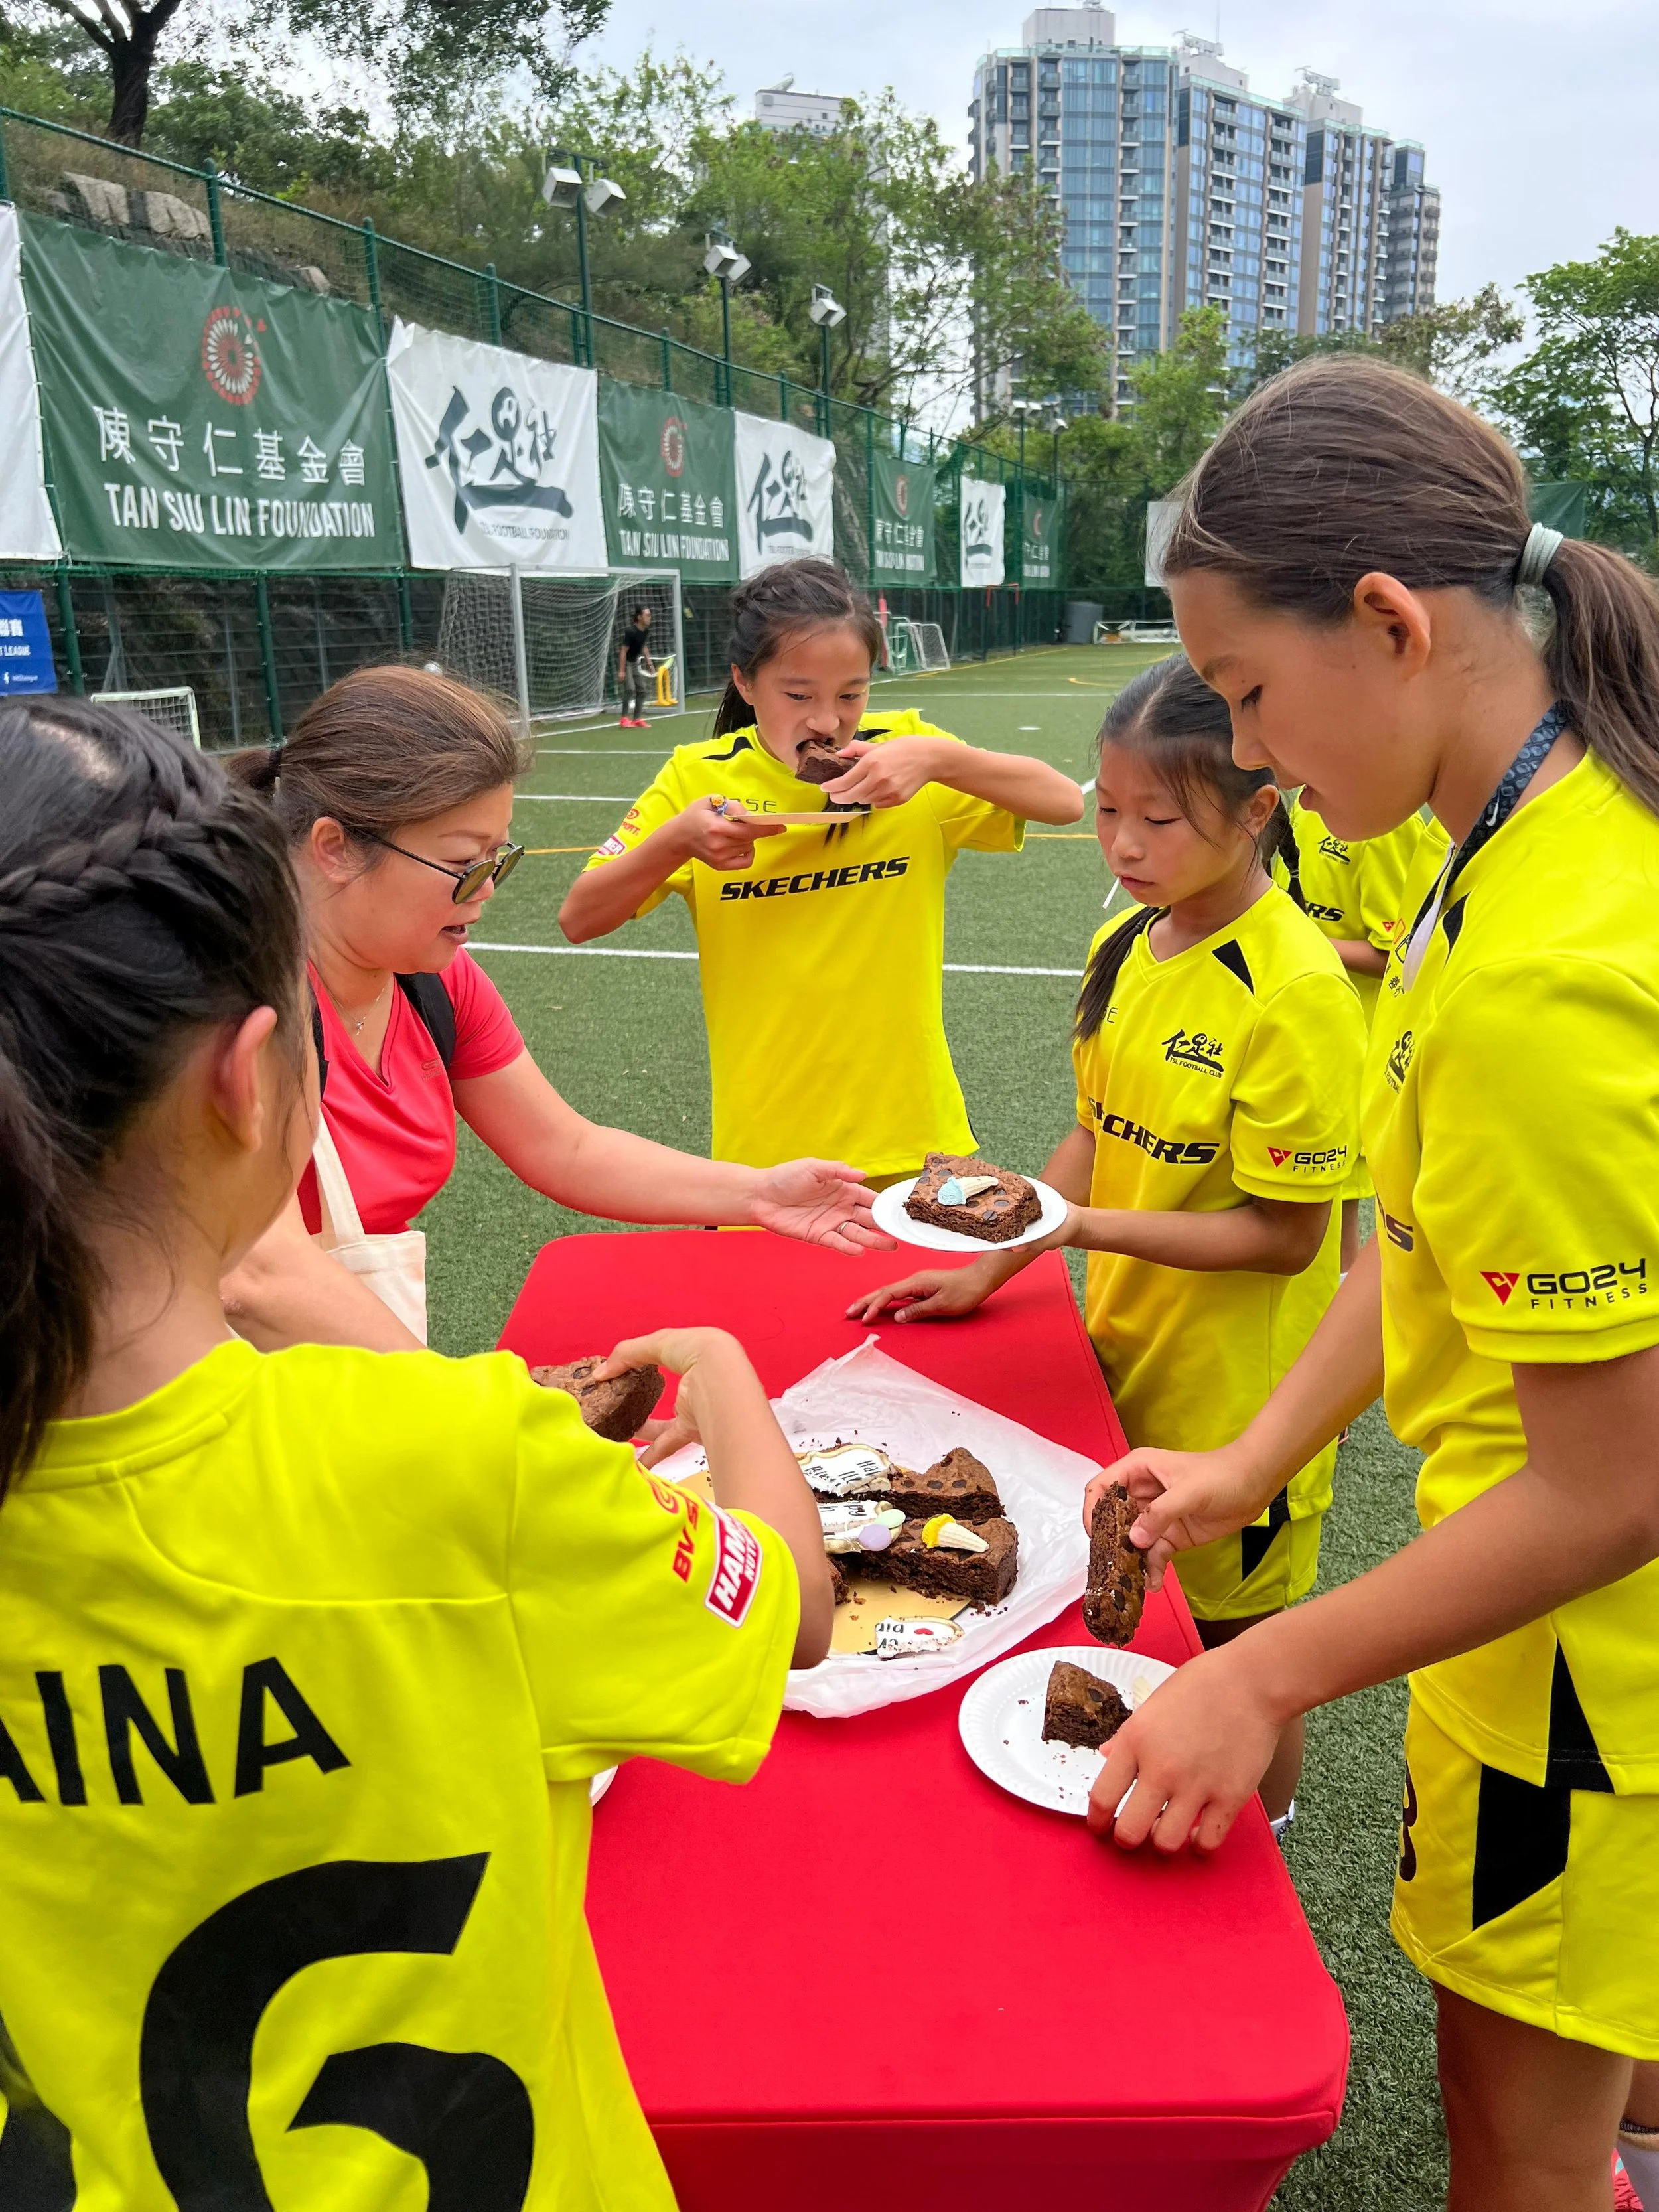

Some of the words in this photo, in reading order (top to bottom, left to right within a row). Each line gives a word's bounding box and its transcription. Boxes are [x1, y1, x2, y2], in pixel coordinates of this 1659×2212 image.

[92, 406, 365, 486] 陳守仁基金會
[104, 482, 159, 529] TAN
[162, 490, 204, 533] SIU
[210, 495, 252, 536] LIN
[257, 498, 376, 537] FOUNDATION
[642, 532, 659, 558] SIU
[729, 798, 777, 814] SE
[720, 856, 910, 901] SKECHERS
[1179, 1061, 1207, 1074] FOOTBALL
[1209, 1070, 1222, 1078] CLUB
[1293, 1160, 1346, 1173] FITNESS
[1294, 1145, 1347, 1165] GO24
[1526, 1258, 1646, 1295] GO24
[1531, 1283, 1647, 1310] FITNESS
[672, 1524, 695, 1584] BV
